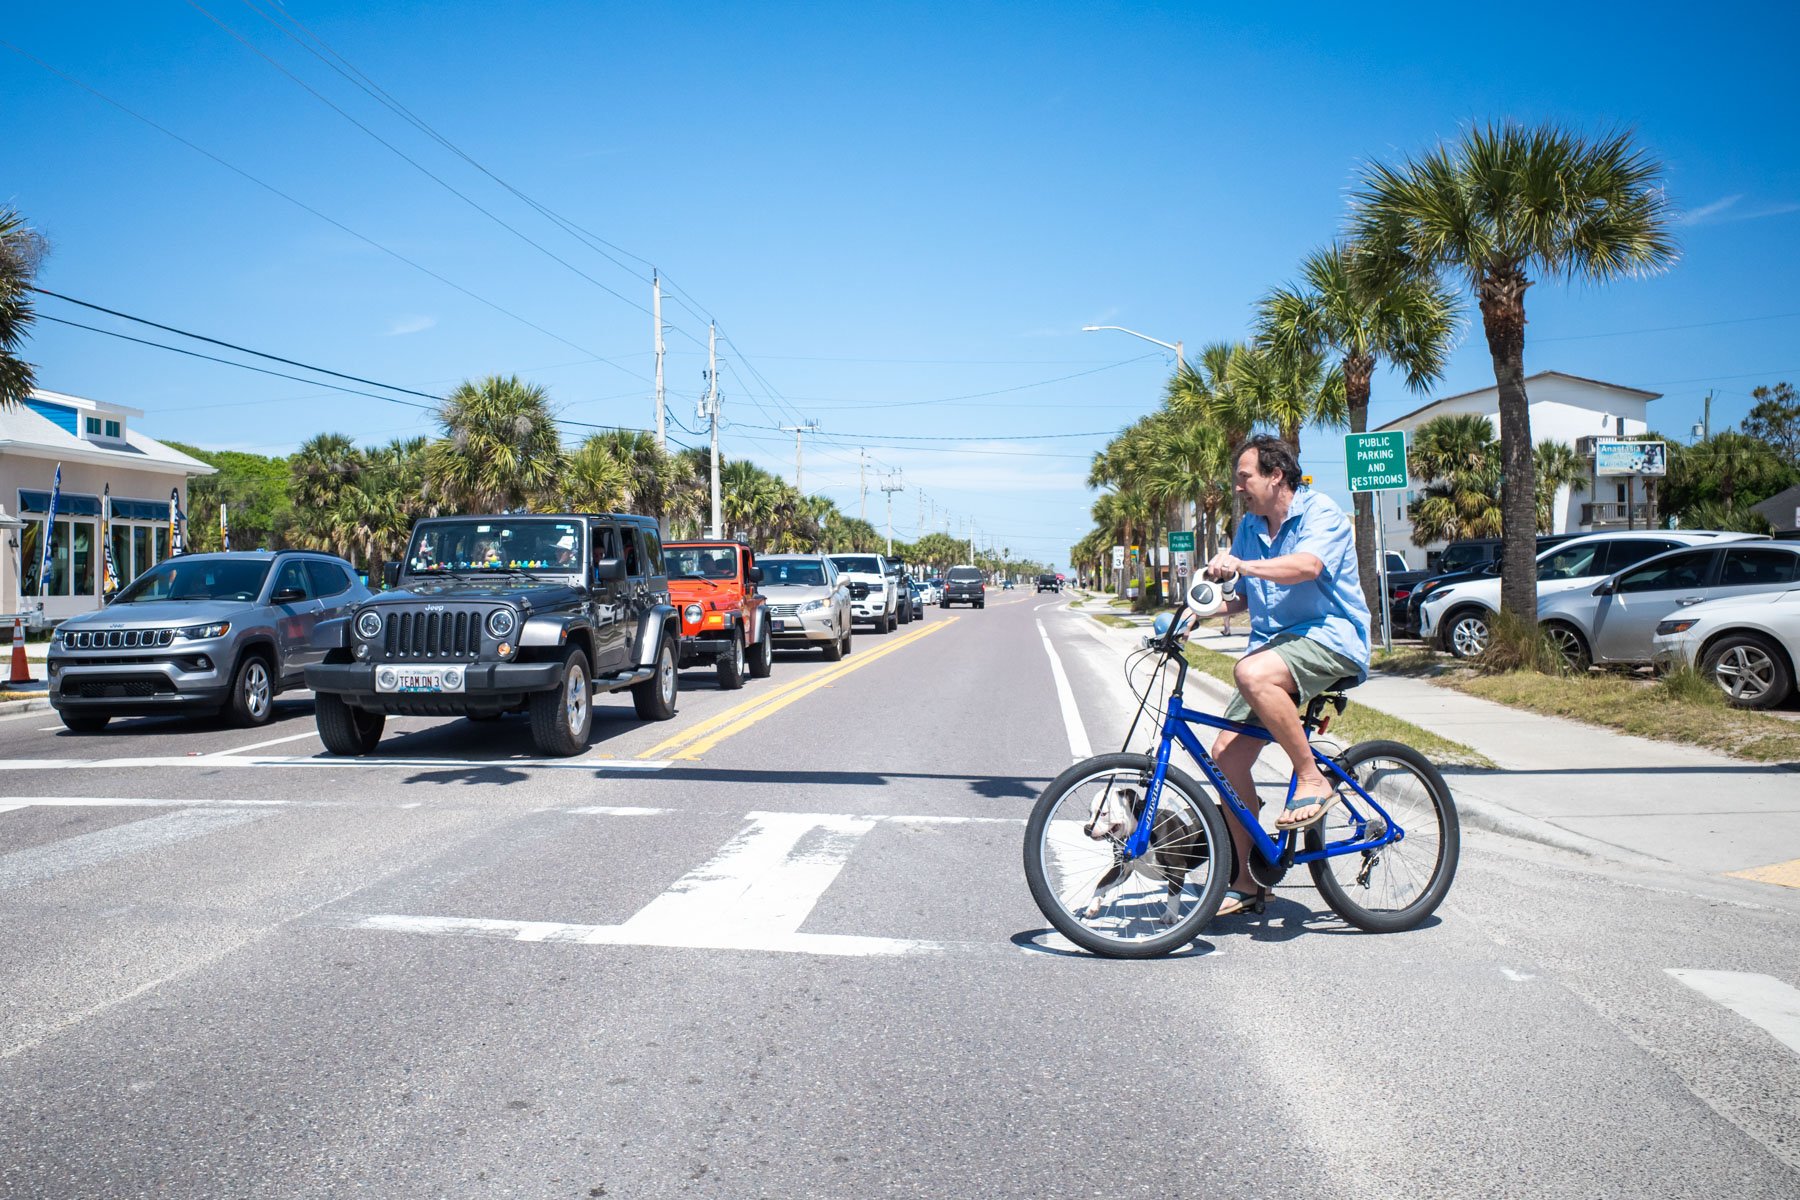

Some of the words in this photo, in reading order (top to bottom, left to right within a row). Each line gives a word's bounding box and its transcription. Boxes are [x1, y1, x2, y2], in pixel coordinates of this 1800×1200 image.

[1359, 437, 1390, 447] PUBLIC
[1357, 449, 1394, 460] PARKING
[1367, 462, 1385, 472] AND
[1351, 474, 1403, 486] RESTROOMS
[400, 676, 419, 687] TEAM
[422, 676, 432, 687] ON
[434, 676, 440, 687] 3
